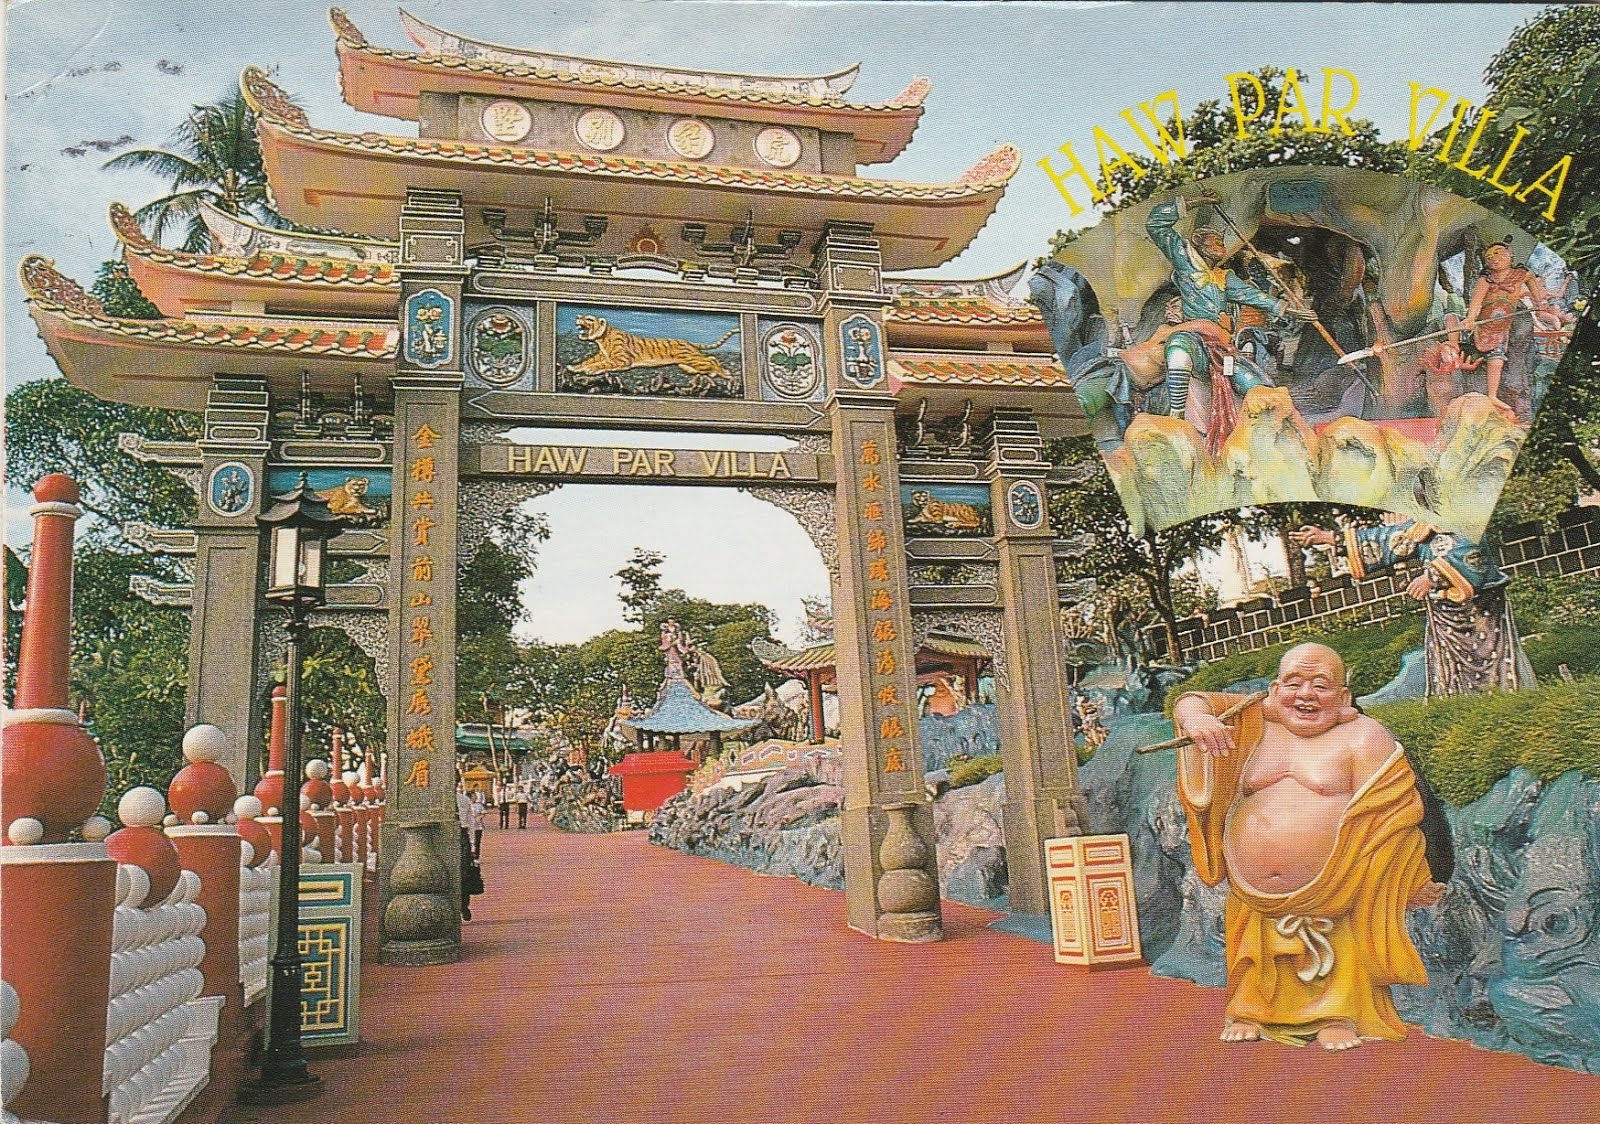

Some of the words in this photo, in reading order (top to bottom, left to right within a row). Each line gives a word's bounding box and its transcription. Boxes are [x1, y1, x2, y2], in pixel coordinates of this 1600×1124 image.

[507, 446, 588, 474] HAW
[612, 448, 676, 476] PAR
[699, 451, 791, 479] VILLA
